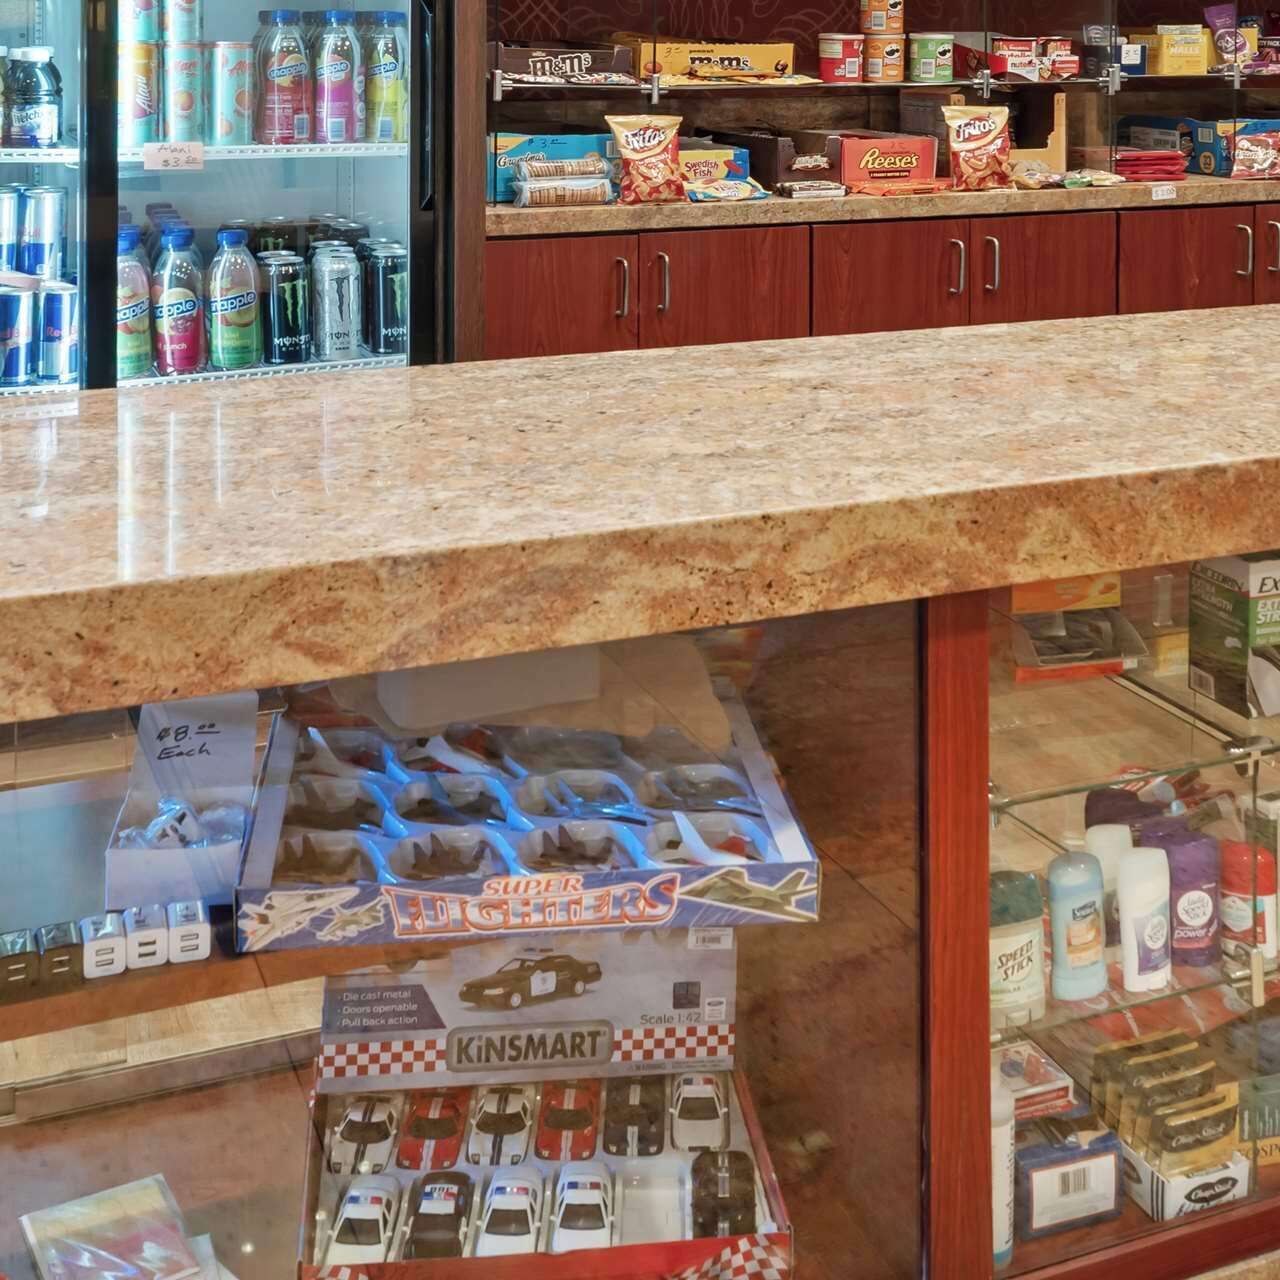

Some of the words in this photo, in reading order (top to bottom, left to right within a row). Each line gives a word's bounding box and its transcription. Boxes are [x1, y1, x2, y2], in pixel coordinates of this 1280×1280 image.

[955, 118, 996, 139] Fritos
[622, 127, 667, 152] Fritos
[685, 160, 719, 172] Swedish
[859, 148, 919, 169] Reese's
[693, 167, 713, 178] Fish
[157, 742, 211, 761] Each
[483, 874, 585, 897] SUPER
[1174, 928, 1206, 940] power
[997, 940, 1034, 969] SPEED
[1001, 953, 1034, 982] STICK
[343, 992, 360, 1001] Die
[360, 991, 380, 1001] cast
[382, 989, 411, 1000] metal
[342, 1005, 371, 1015] Doors
[372, 1002, 418, 1014] openable
[341, 1017, 361, 1027] Pull
[362, 1016, 386, 1027] back
[387, 1015, 418, 1026] action
[639, 1013, 675, 1026] Scale
[455, 1030, 602, 1065] KiNSMART
